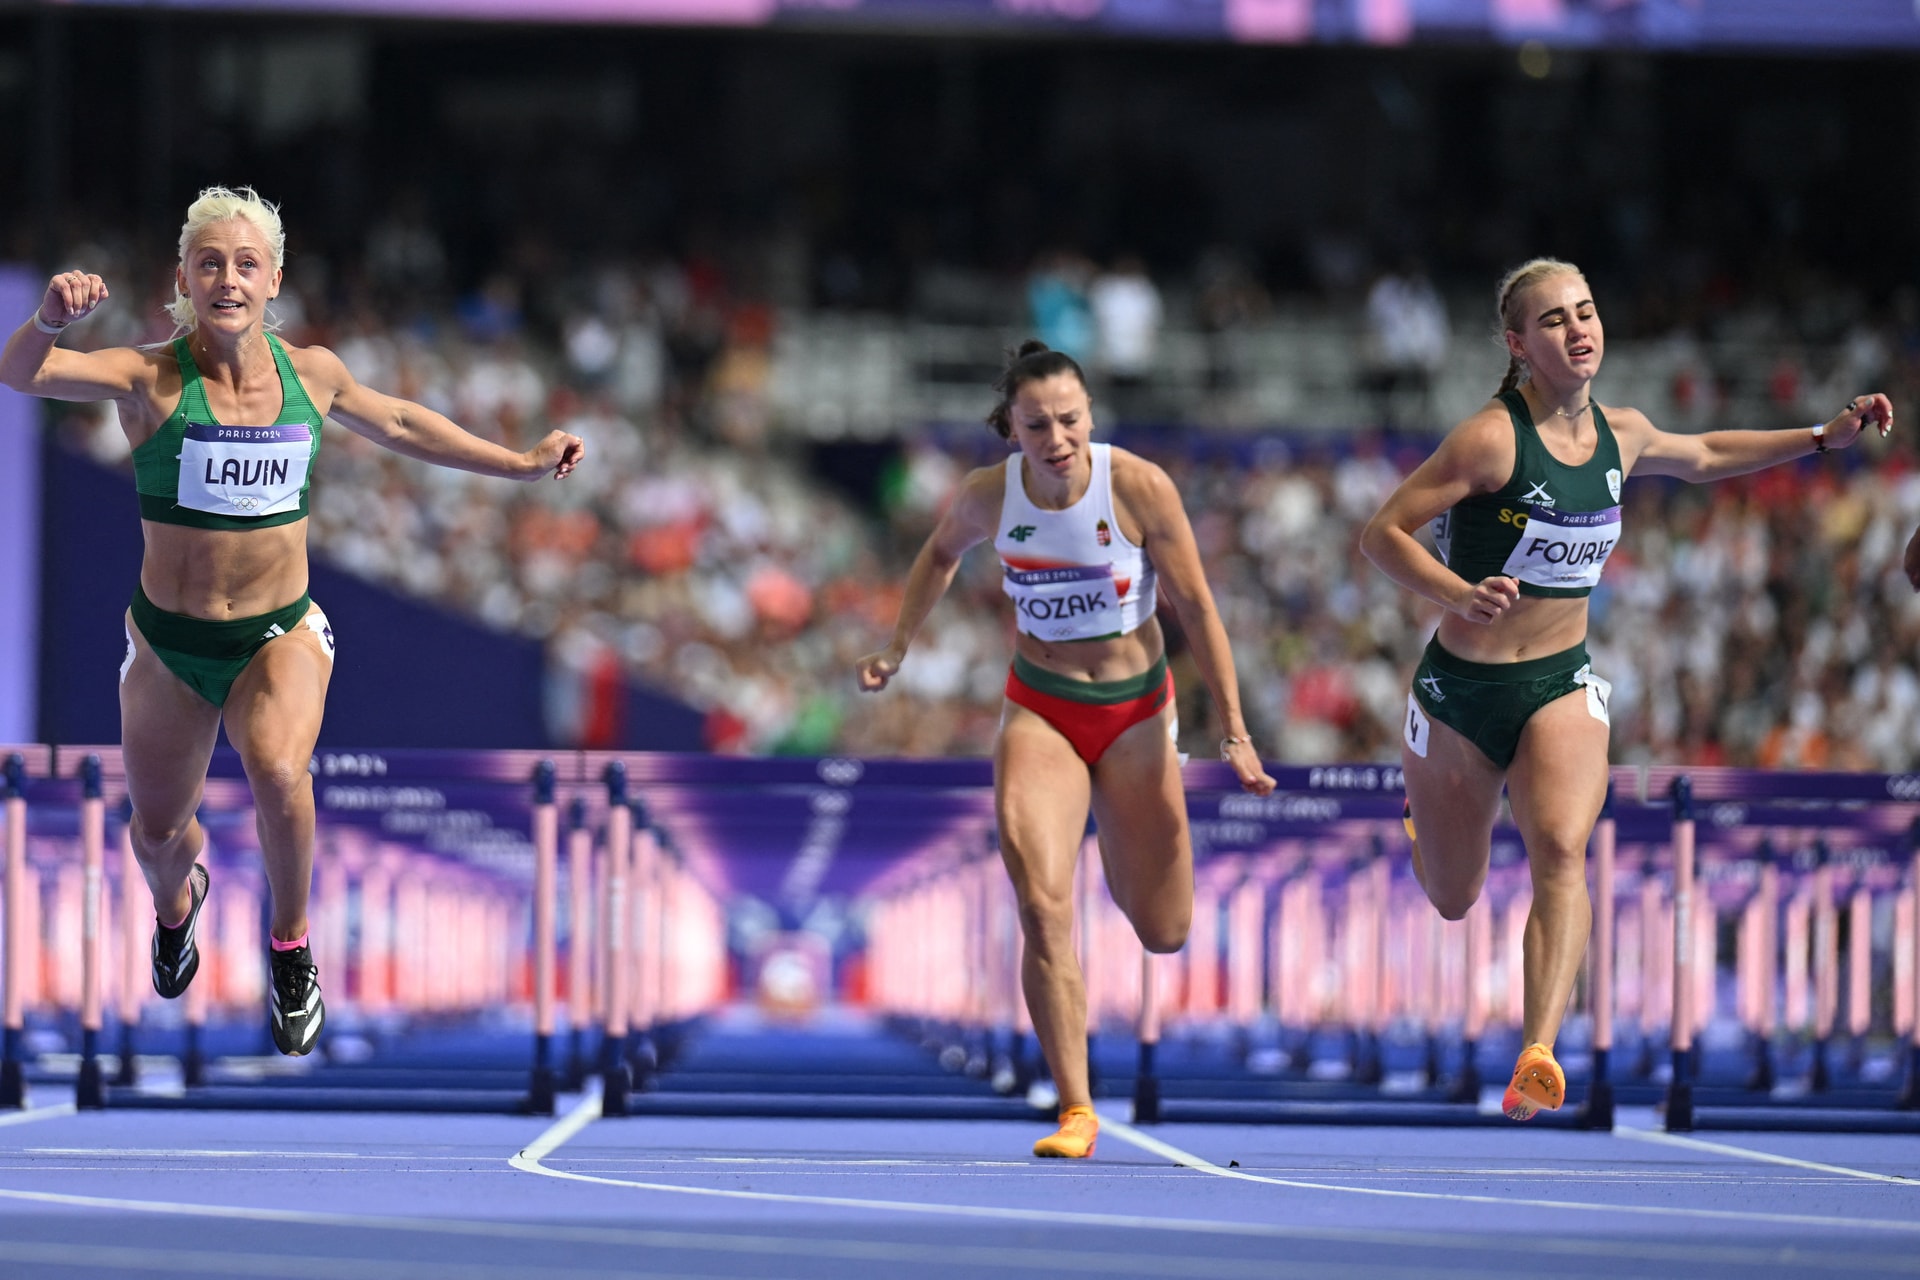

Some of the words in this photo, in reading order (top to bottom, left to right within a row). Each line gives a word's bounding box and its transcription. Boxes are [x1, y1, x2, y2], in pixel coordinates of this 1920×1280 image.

[218, 429, 251, 439] PARIS
[254, 430, 281, 439] 2024
[204, 457, 289, 487] LAVIN
[1562, 515, 1588, 524] PARIS
[1007, 524, 1037, 543] 4F
[1012, 591, 1107, 620] KOZAK
